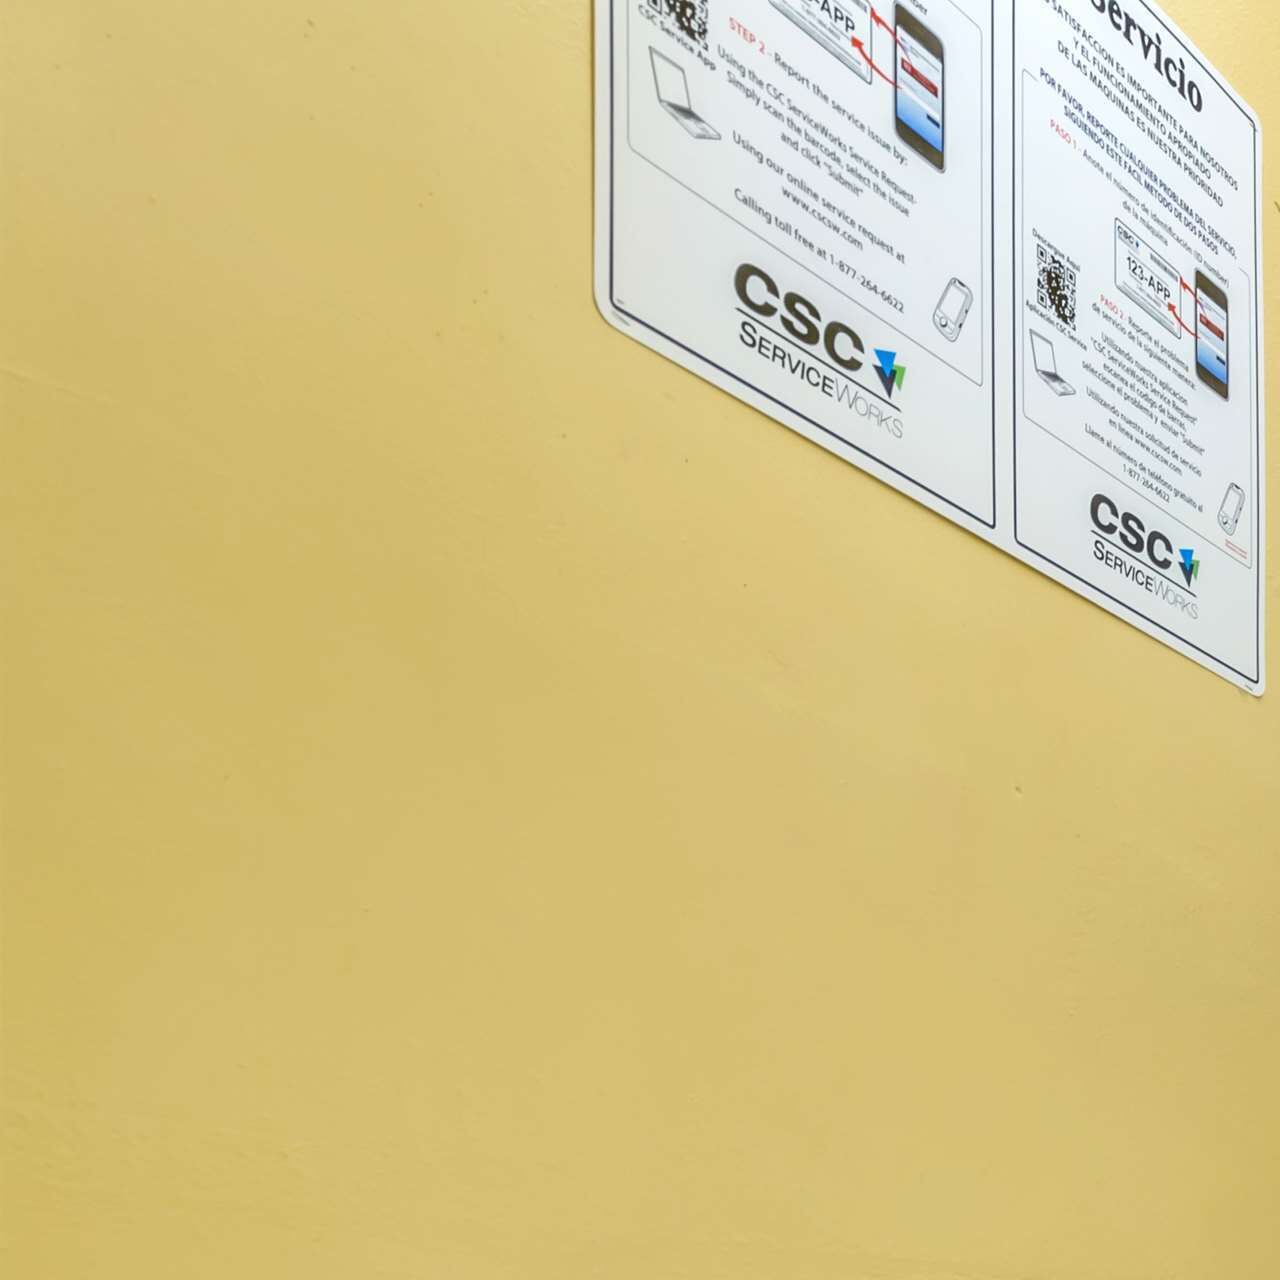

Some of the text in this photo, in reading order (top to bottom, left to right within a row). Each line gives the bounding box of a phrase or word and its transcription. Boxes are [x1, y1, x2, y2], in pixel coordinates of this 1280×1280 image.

[729, 17, 756, 43] STEP
[774, 52, 809, 89] Report
[811, 83, 829, 104] the
[831, 100, 865, 132] service
[867, 126, 891, 152] issue
[732, 130, 904, 264] Using our online service request at
[733, 187, 772, 225] Calling
[774, 215, 792, 236] toll
[793, 228, 814, 252] free
[816, 247, 826, 260] at
[782, 187, 863, 250] www.cscsw.com
[734, 263, 864, 371] CSC
[1126, 255, 1171, 300] 123-APP
[1089, 493, 1173, 581] CSC
